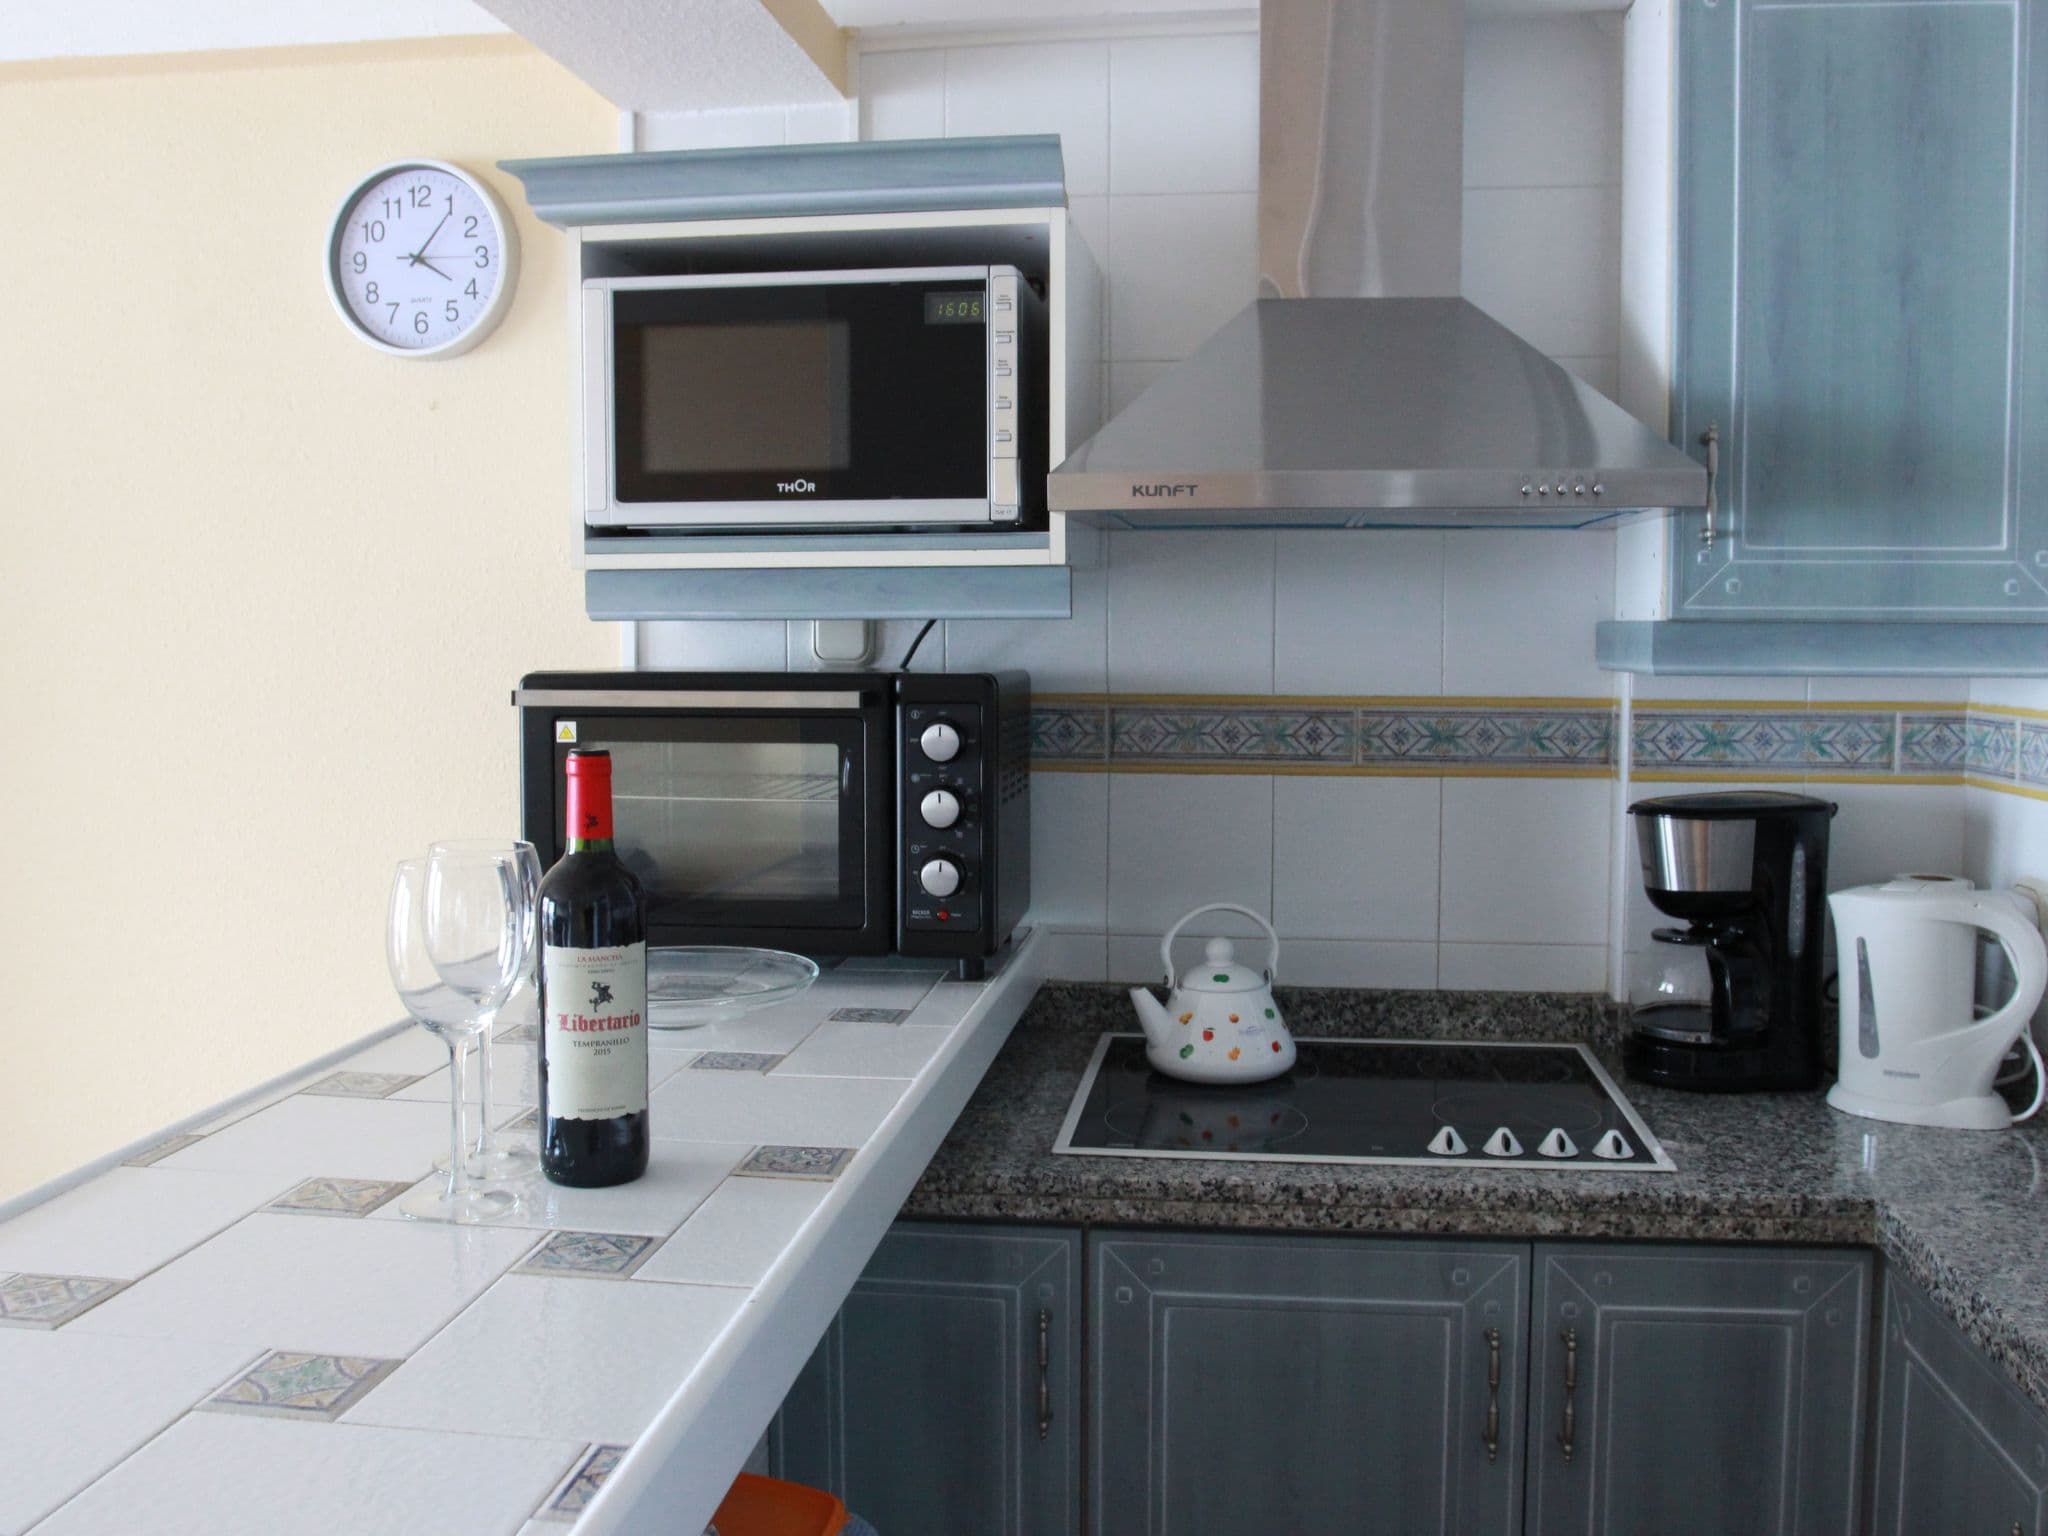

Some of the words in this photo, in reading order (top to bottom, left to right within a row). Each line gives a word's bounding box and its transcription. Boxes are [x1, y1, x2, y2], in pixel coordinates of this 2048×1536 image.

[408, 185, 432, 208] 12
[445, 194, 453, 216] 1
[383, 198, 401, 219] 11
[362, 220, 385, 243] 10
[464, 216, 478, 238] 2
[353, 251, 367, 274] 9
[474, 245, 489, 268] 3
[366, 281, 379, 304] 8
[464, 278, 479, 300] 4
[386, 302, 400, 325] 7
[445, 300, 459, 322] 5
[414, 312, 429, 334] 6
[776, 479, 816, 492] THOR
[558, 1009, 641, 1033] Libertario
[573, 1036, 630, 1048] TEMPRANILLO
[593, 1048, 611, 1056] 2015
